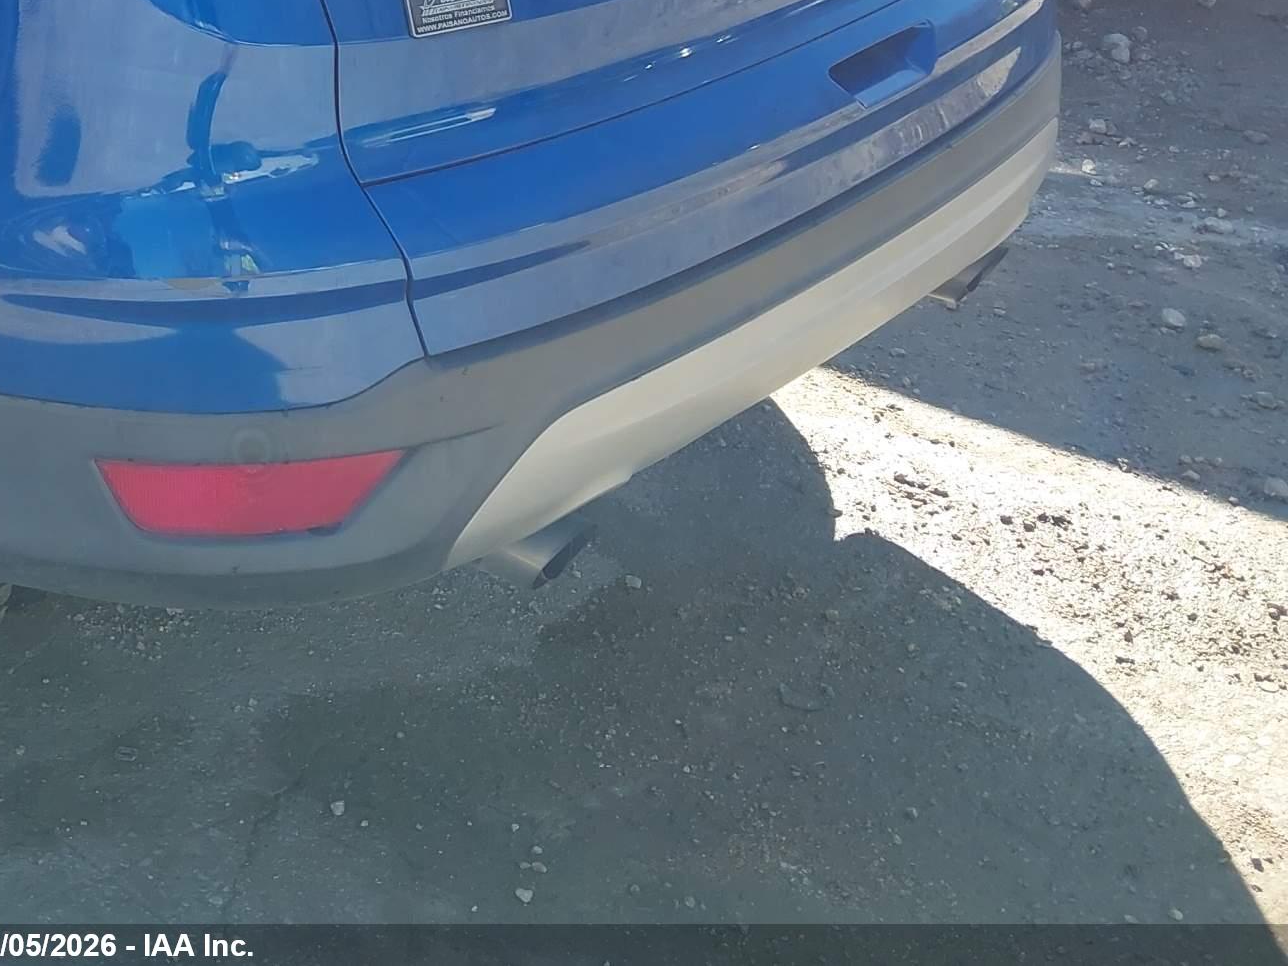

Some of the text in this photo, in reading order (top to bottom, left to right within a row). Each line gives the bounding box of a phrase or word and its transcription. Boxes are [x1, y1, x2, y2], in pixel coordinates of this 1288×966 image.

[416, 10, 508, 33] WWW.PAISANOAUTOS.COM
[422, 10, 453, 24] Nosotros
[454, 5, 496, 19] Financiamos
